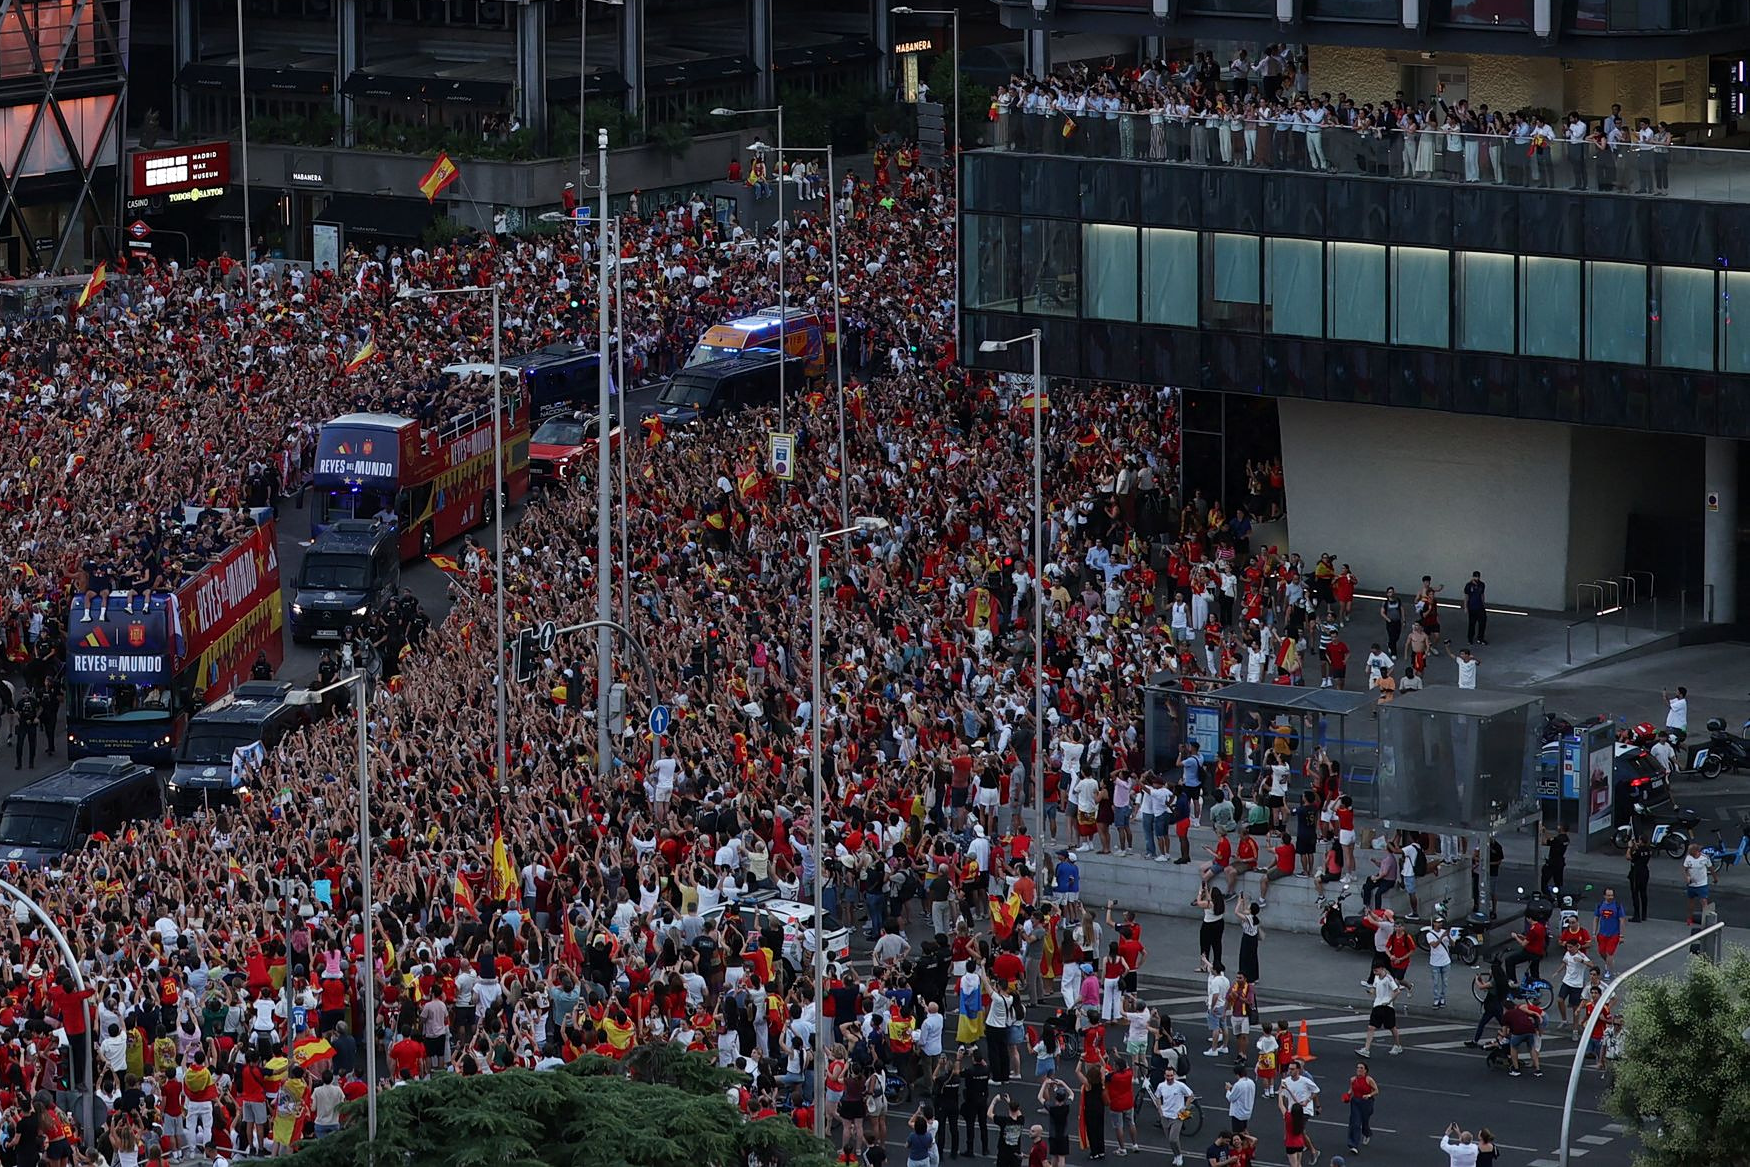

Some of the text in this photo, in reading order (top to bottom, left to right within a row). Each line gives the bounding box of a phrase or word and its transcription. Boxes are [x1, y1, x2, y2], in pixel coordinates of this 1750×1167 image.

[895, 40, 932, 54] HABANERA
[192, 151, 217, 160] MADRID
[193, 171, 219, 180] MUSEUM
[292, 172, 322, 182] HABANERA
[169, 188, 223, 202] TODOS SANTOS
[127, 198, 149, 208] CASINO
[540, 407, 572, 417] NACIONAL
[451, 437, 467, 466] REYES
[472, 425, 492, 457] MUNDO
[320, 459, 345, 474] REYES
[354, 460, 392, 477] MUNDO
[196, 575, 222, 634] REYES
[225, 547, 257, 610] MUNDO
[75, 655, 162, 673] REYES DEL MUNDO
[163, 984, 176, 995] 20
[294, 1015, 303, 1026] 10
[1284, 1042, 1290, 1054] 9
